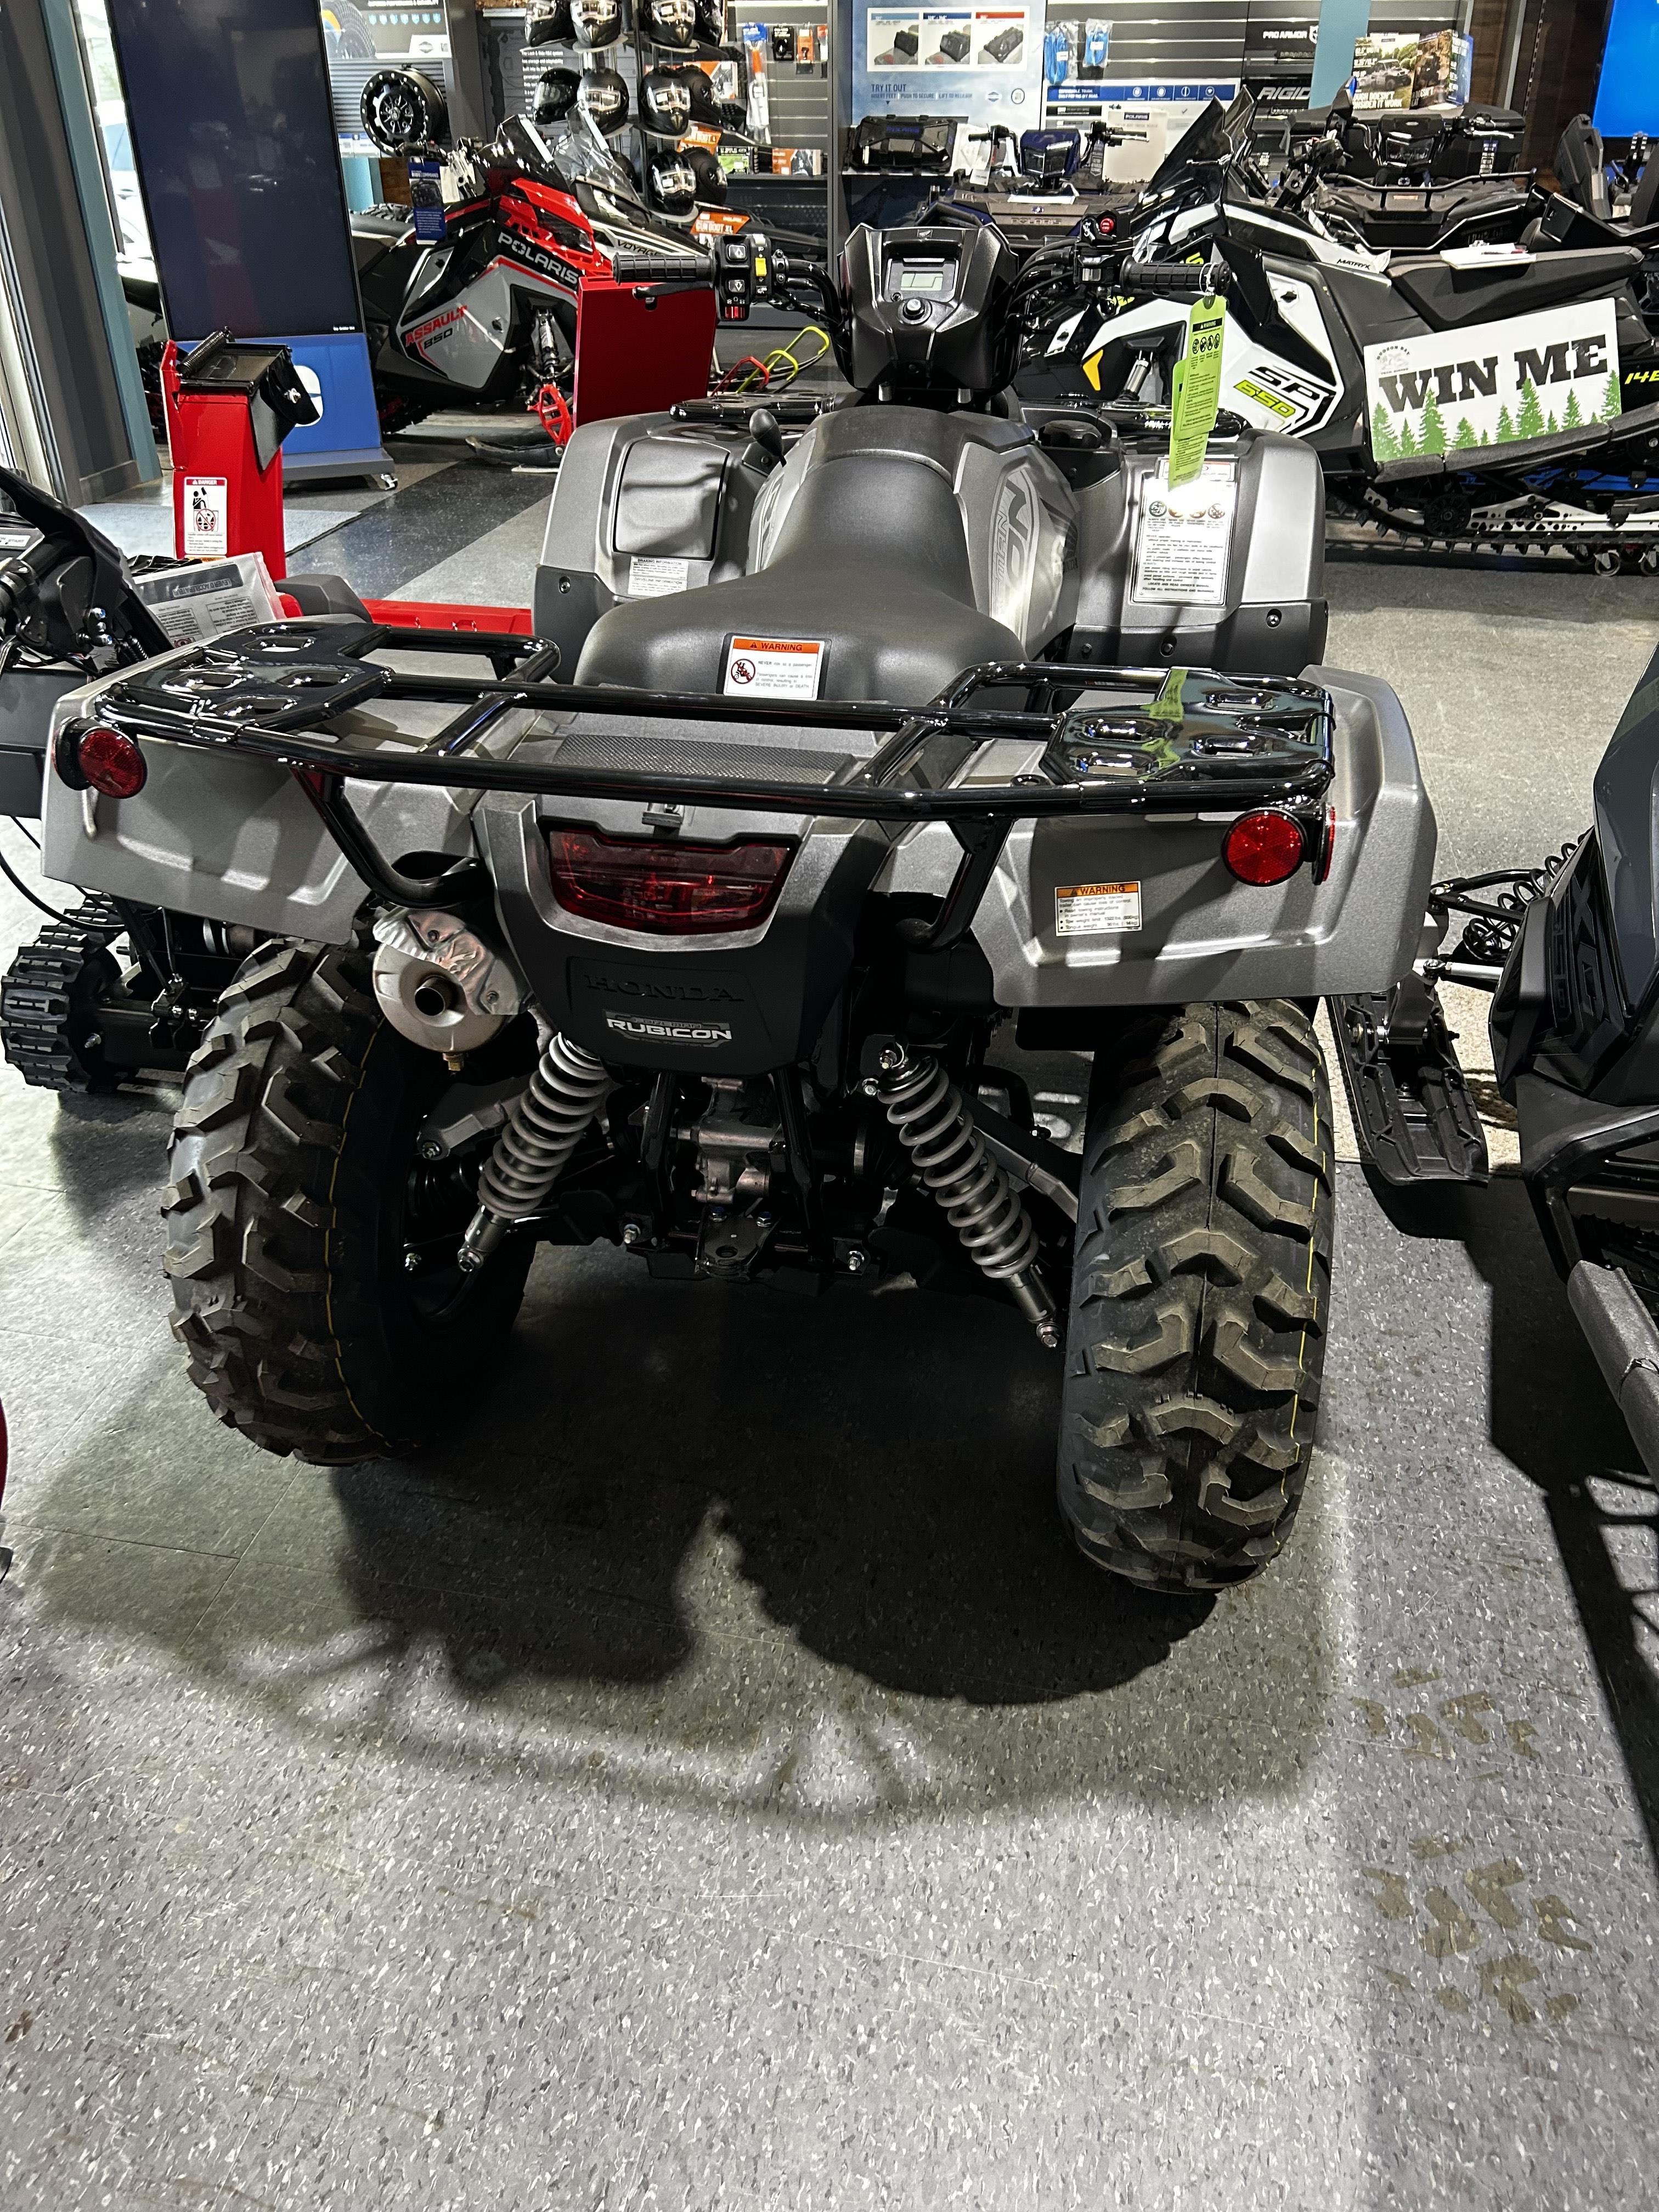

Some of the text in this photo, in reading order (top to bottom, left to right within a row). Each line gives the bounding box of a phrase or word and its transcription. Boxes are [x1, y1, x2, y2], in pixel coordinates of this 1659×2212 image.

[498, 232, 579, 285] POLARIS
[1336, 258, 1371, 270] MATRYX
[405, 305, 468, 347] ASSAULT
[424, 328, 453, 349] 850
[1378, 334, 1609, 413] WIN ME
[1233, 379, 1296, 419] 650
[761, 642, 803, 651] WARNING
[1080, 884, 1125, 895] WARNING
[583, 975, 745, 1002] HONDA
[606, 1018, 732, 1040] RUBICON
